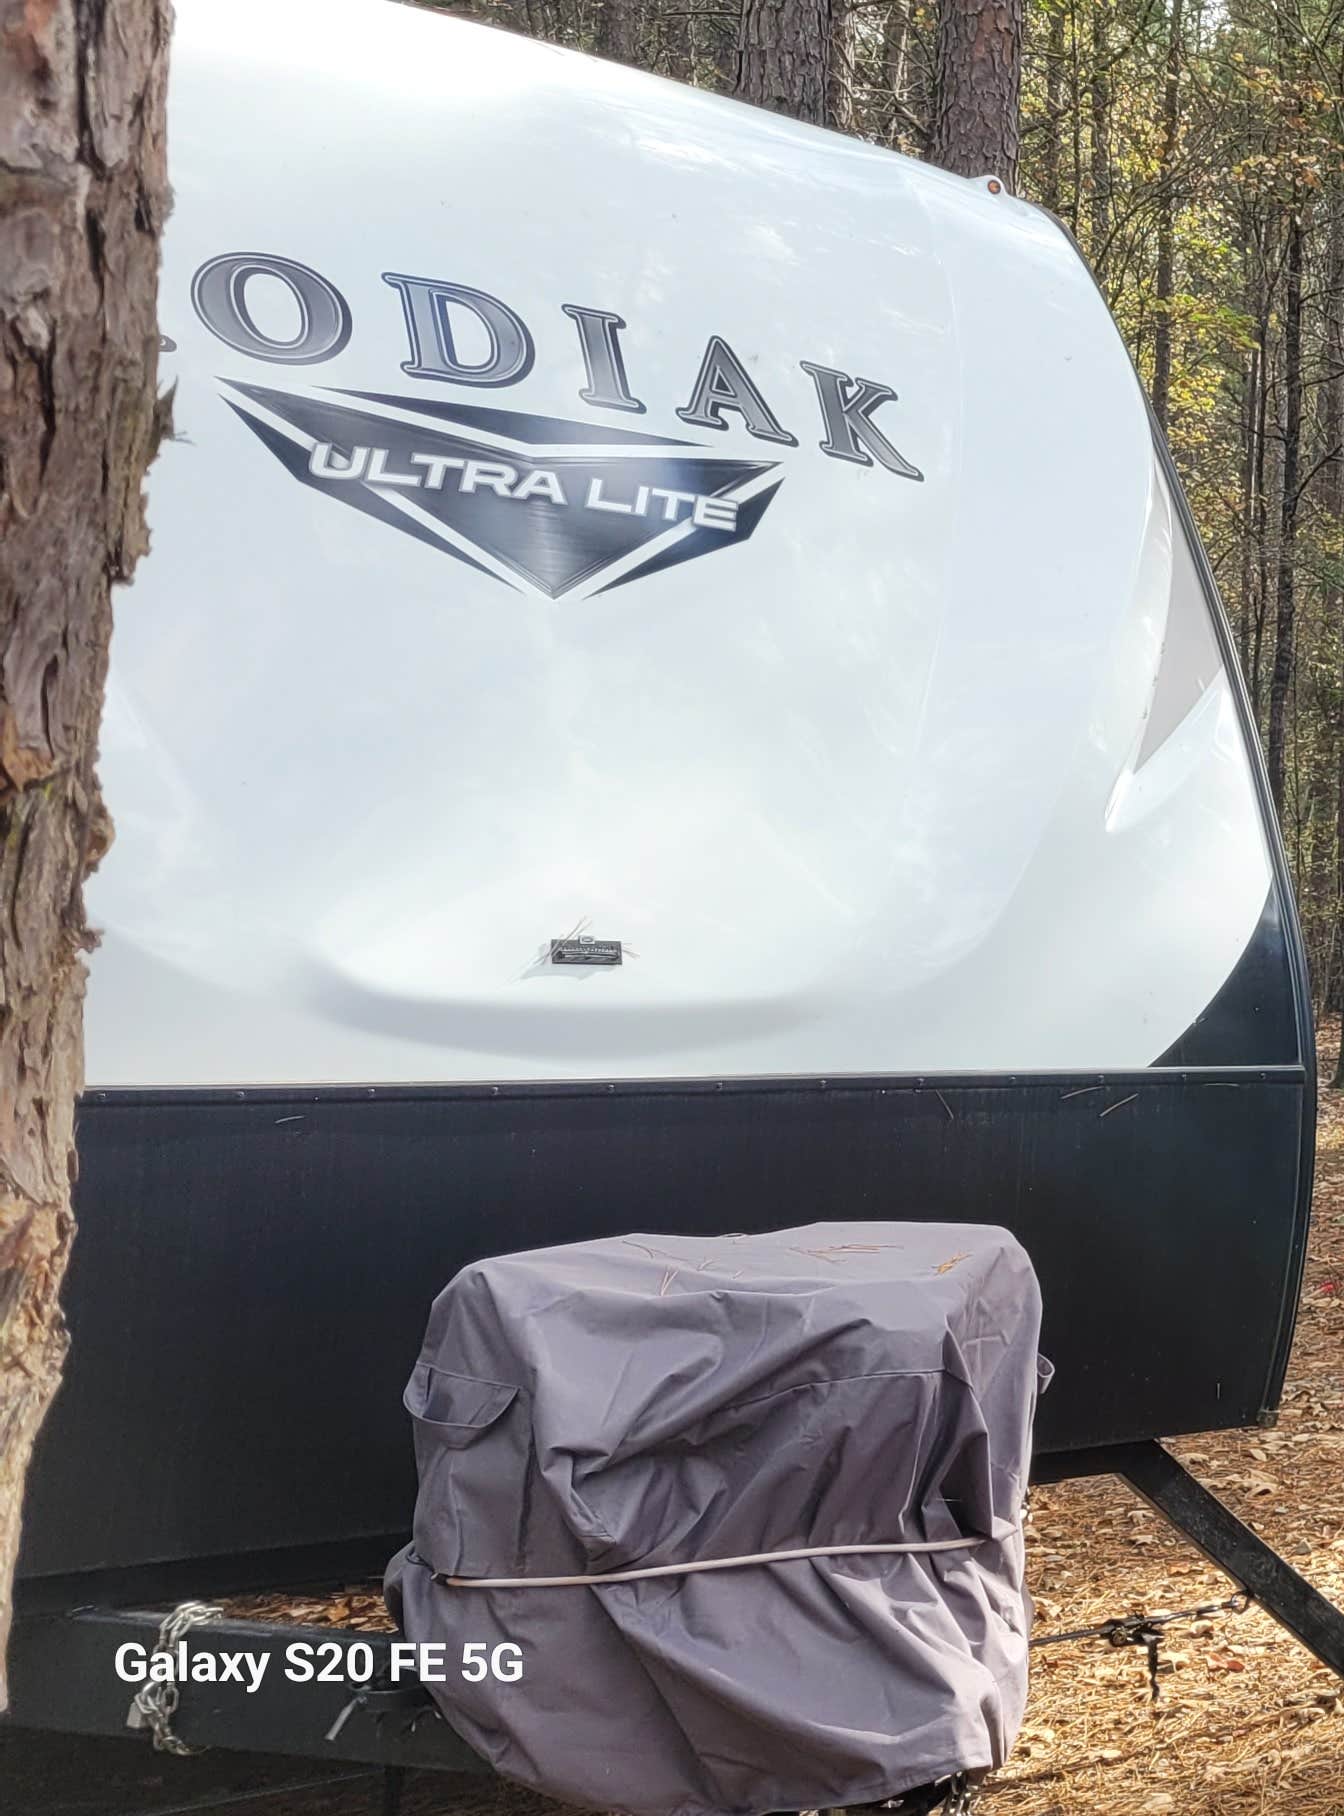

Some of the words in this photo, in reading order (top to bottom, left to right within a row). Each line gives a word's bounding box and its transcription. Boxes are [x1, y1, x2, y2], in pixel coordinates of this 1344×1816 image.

[159, 250, 926, 484] ODIAK
[307, 442, 569, 506] ULTRA
[584, 477, 739, 532] LITE
